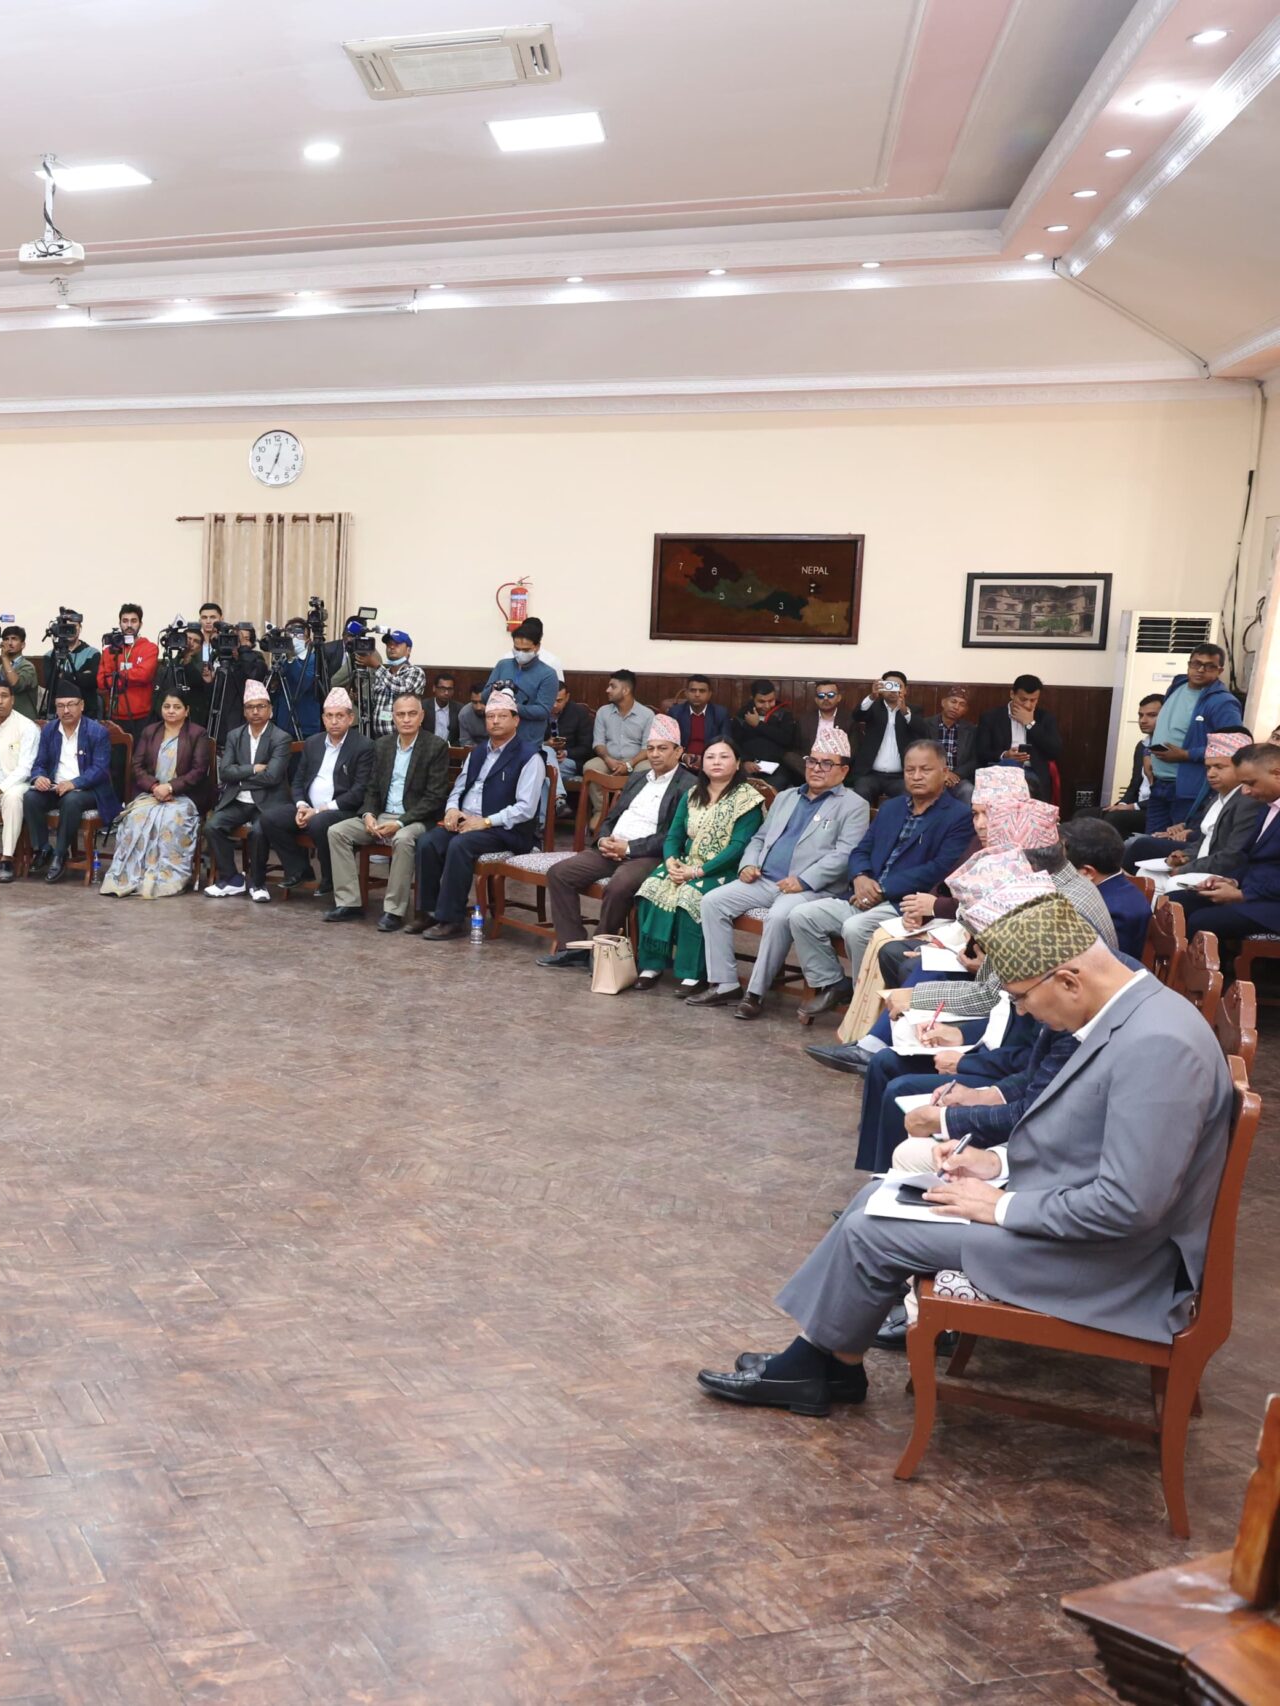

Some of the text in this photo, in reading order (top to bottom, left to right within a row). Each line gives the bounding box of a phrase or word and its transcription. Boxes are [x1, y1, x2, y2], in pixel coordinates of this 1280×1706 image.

[711, 566, 717, 575] 6
[801, 566, 829, 576] NEPAL
[719, 592, 725, 600] 5
[778, 602, 784, 610] 3
[774, 615, 779, 623] 2
